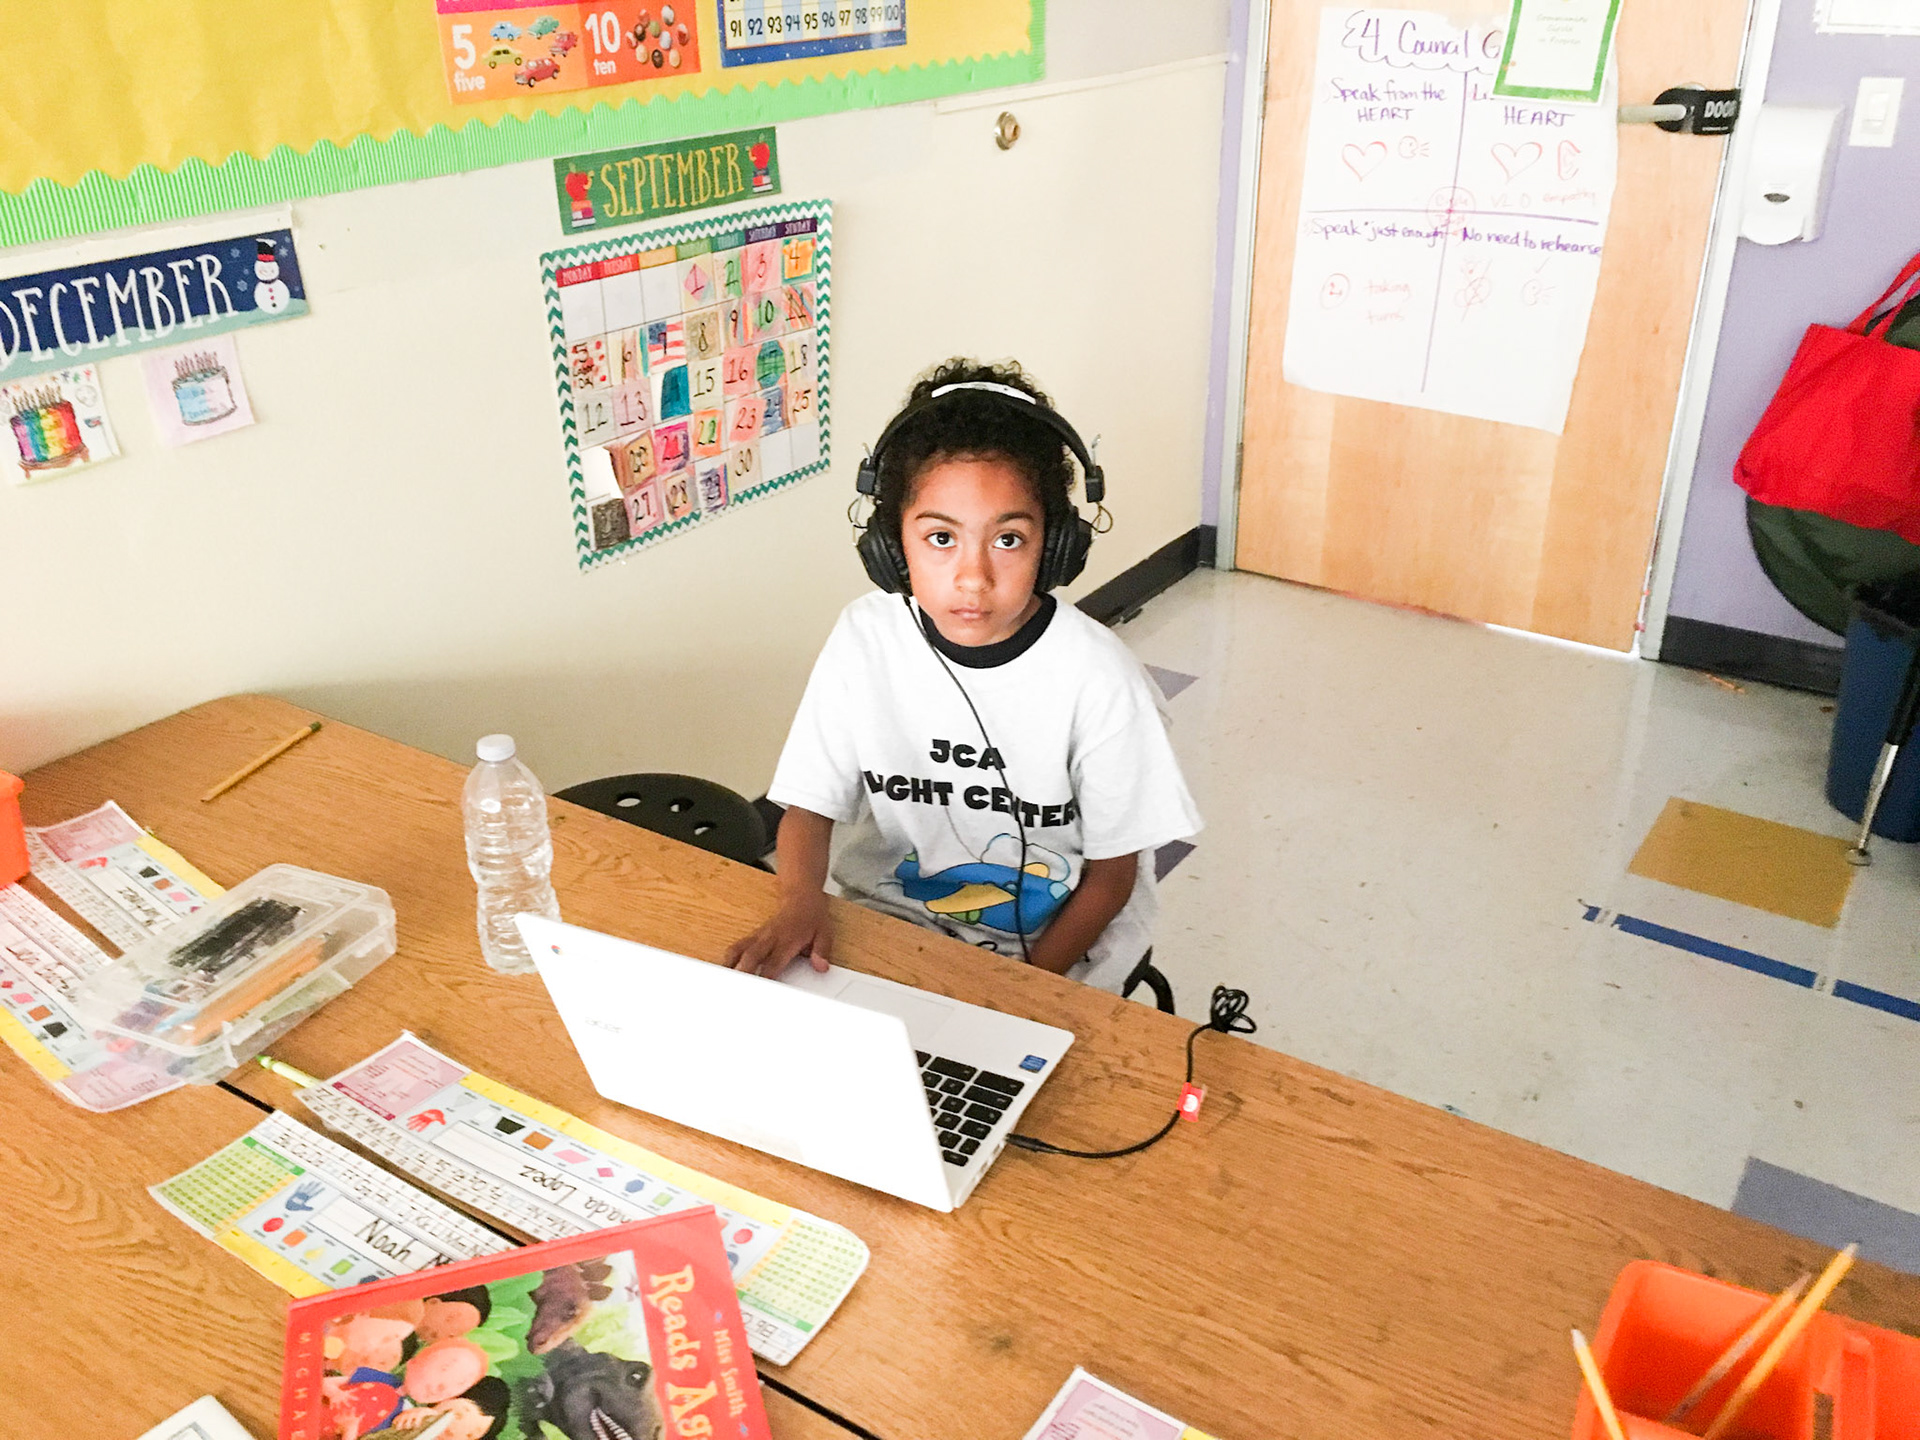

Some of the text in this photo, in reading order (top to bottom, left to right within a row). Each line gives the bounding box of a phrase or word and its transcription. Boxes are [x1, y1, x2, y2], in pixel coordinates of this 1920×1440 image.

[452, 11, 622, 70] 5 10
[730, 5, 899, 37] 91 92 93 94 95 96 97 98 99 100
[1399, 20, 1469, 58] Council
[453, 57, 617, 94] five ten
[1331, 77, 1381, 102] Speak
[1383, 79, 1418, 102] from
[1421, 81, 1447, 101] the
[1357, 107, 1414, 122] HEART
[1503, 107, 1575, 128] HEART
[600, 142, 745, 218] SEPTEMBER
[784, 219, 811, 234] SUNDAY
[1312, 218, 1361, 241] Speak
[1462, 226, 1604, 255] No need to rehearse
[724, 260, 739, 286] 2
[757, 253, 767, 279] 3
[789, 239, 802, 271] 4
[0, 253, 238, 371] DECEMBER
[573, 342, 590, 363] 5
[698, 322, 709, 352] 8
[729, 308, 738, 340] 9
[757, 300, 774, 325] 10
[583, 402, 608, 434] 12
[620, 391, 648, 426] 13
[693, 367, 716, 397] 15
[725, 357, 748, 384] 16
[735, 406, 757, 430] 23
[792, 388, 812, 413] 25
[735, 447, 753, 477] 30
[929, 738, 1006, 771] JCA
[963, 785, 1076, 828] CETER
[518, 1164, 578, 1205] Lopez
[355, 1217, 413, 1263] Noah
[646, 1263, 702, 1372] Reads
[713, 1328, 748, 1418] Miss Smith
